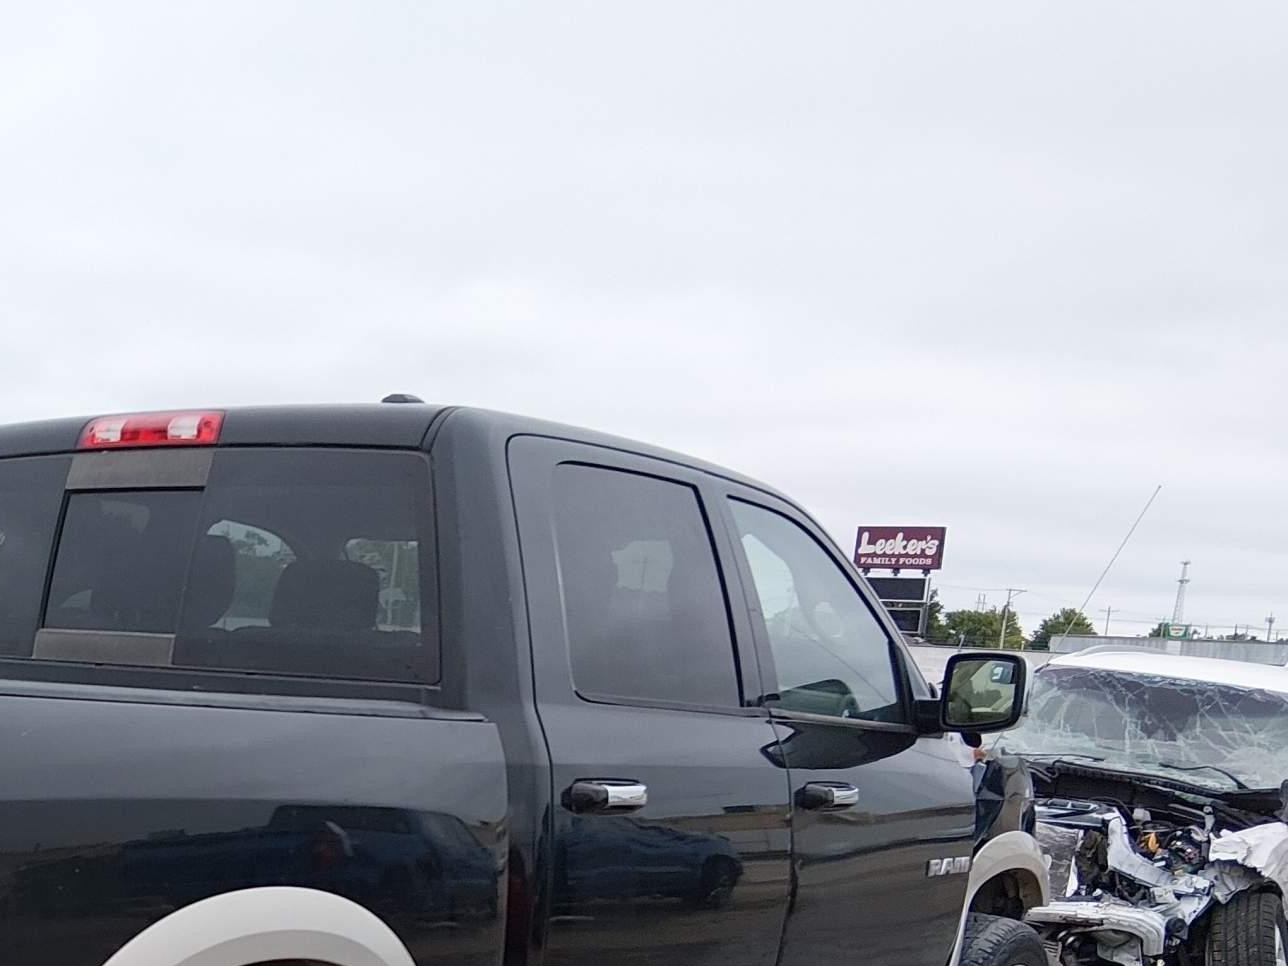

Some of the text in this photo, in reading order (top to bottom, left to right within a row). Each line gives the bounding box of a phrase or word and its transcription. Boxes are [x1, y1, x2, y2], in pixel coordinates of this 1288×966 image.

[858, 531, 940, 556] Leeker's
[860, 557, 933, 565] FAMILY FOODS
[926, 856, 970, 877] RAM
